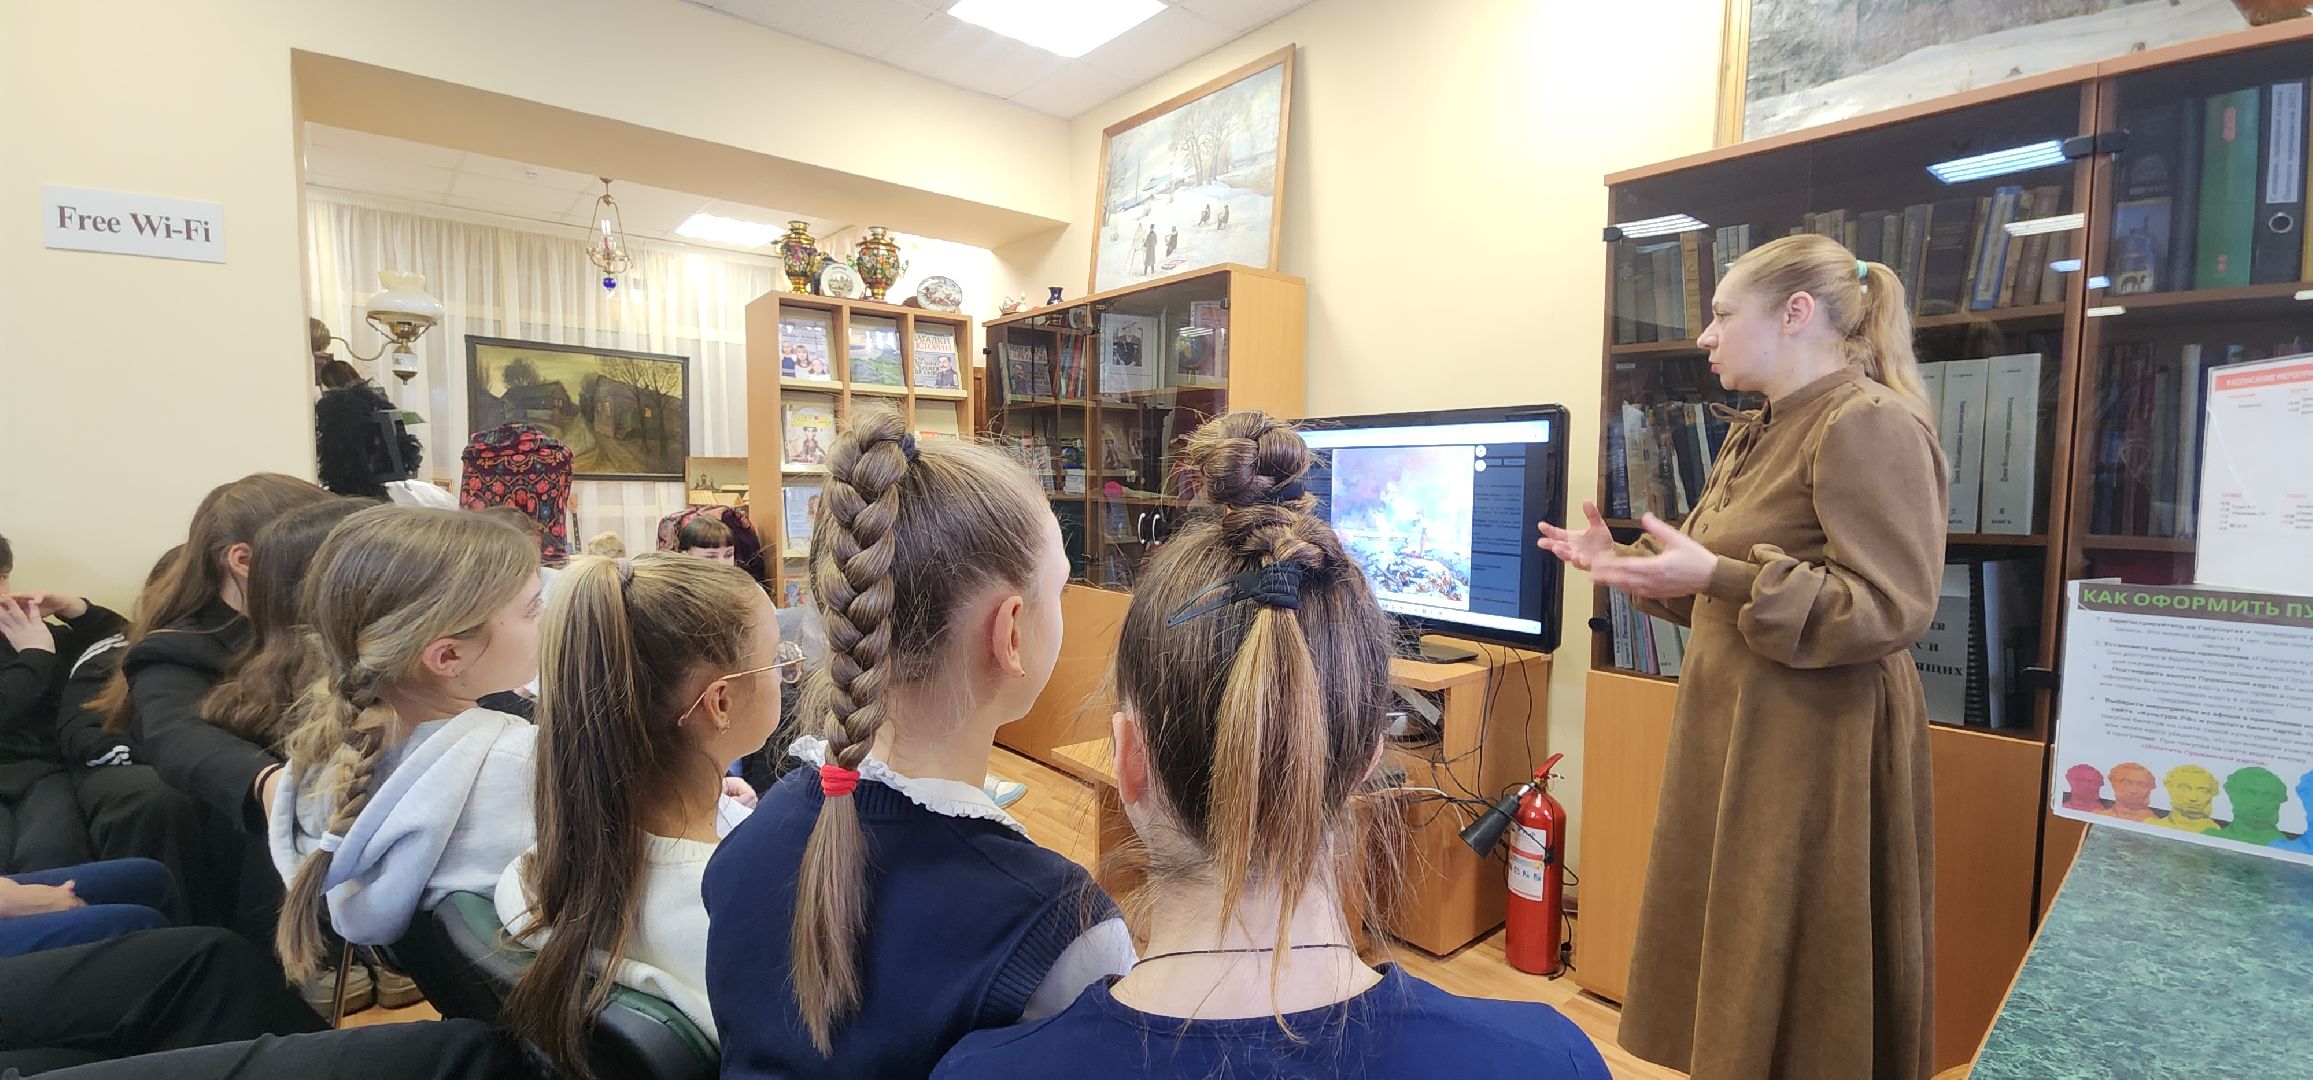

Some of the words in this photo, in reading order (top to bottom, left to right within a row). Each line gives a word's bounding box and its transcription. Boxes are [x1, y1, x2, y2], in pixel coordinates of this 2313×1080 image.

[57, 205, 121, 233] Free
[129, 212, 212, 243] Wi-Fi
[2083, 589, 2128, 605] КАК
[2133, 592, 2281, 617] ОФОРМИТЬ
[1916, 662, 1963, 677] ЯЩИХ
